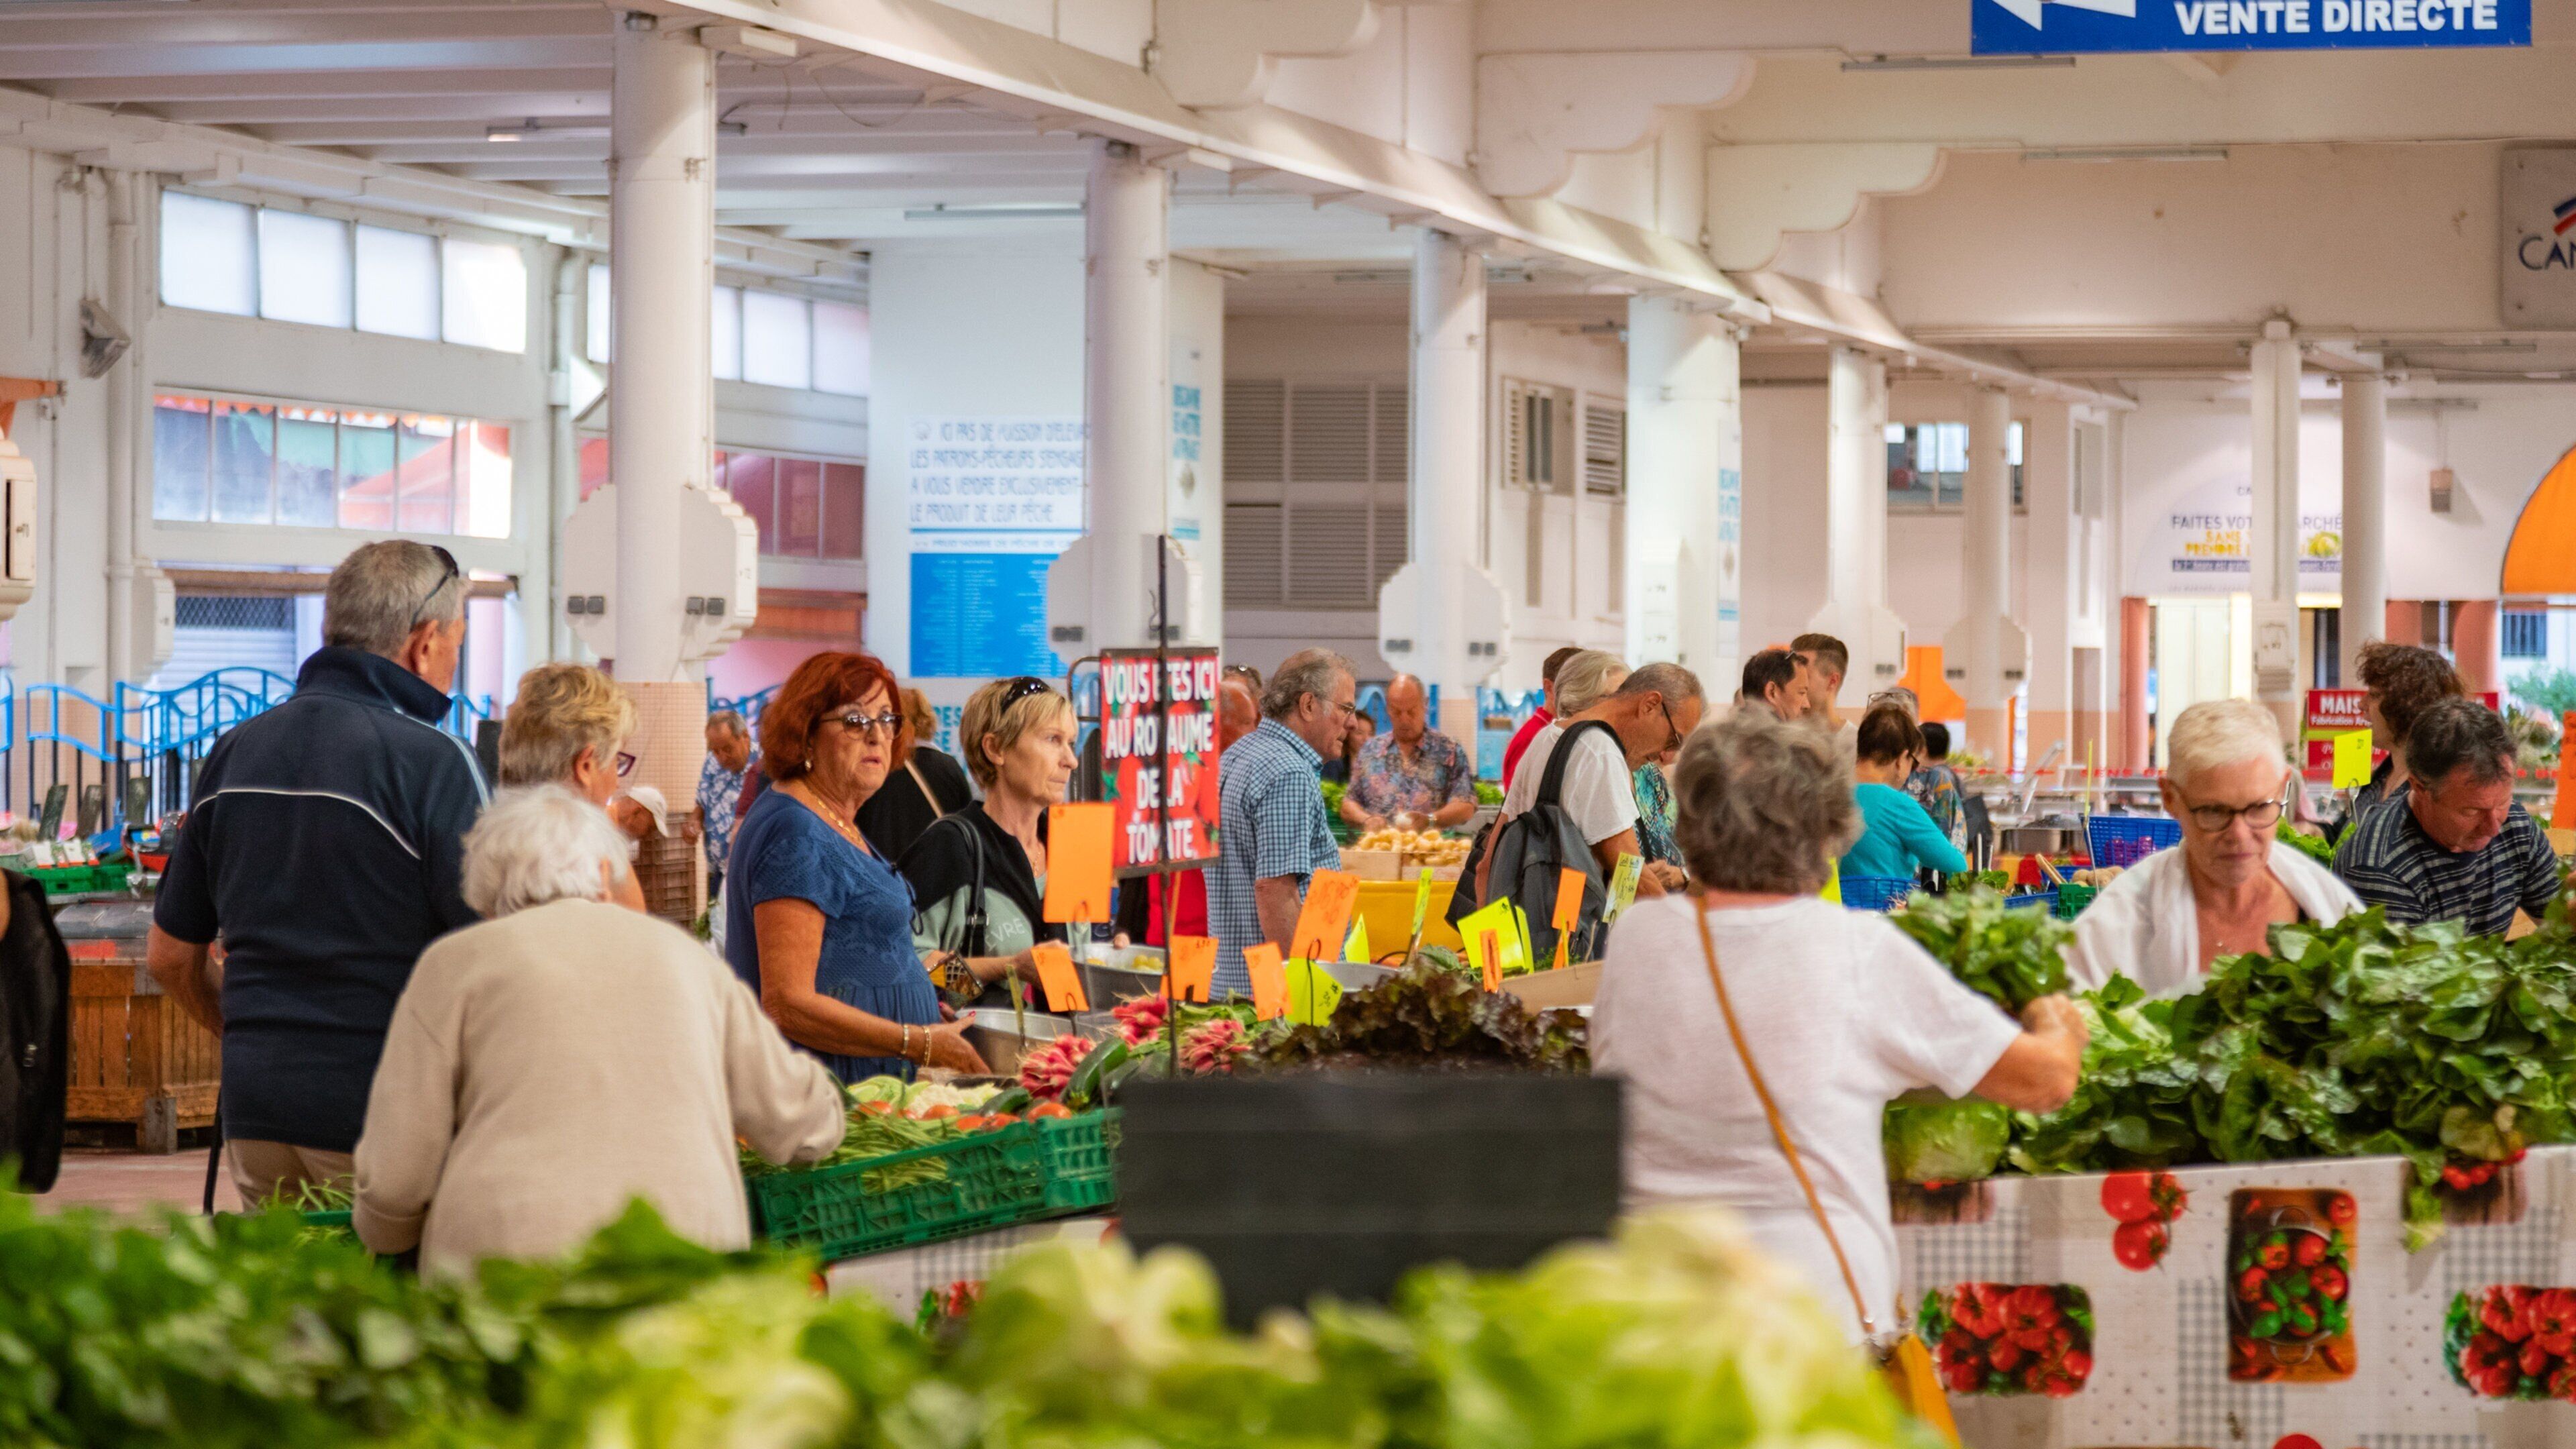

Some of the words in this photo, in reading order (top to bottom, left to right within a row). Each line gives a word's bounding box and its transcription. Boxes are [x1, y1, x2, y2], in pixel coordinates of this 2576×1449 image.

[2174, 1, 2310, 35] VENTE
[2322, 0, 2498, 32] DIRECTE
[910, 449, 929, 468] LES
[923, 476, 951, 495] VOUS
[910, 503, 922, 522] LE
[927, 503, 969, 522] PRODUIT
[975, 503, 987, 522] DE
[991, 503, 1016, 522] LEUR
[2171, 515, 2222, 530] FAITES
[1102, 661, 1150, 704] VOUS
[1194, 659, 1215, 700] ICI
[2311, 715, 2353, 725] Fabrication
[1106, 718, 1131, 759] AU
[1133, 711, 1214, 757] ROAUME
[1136, 767, 1159, 809] DE
